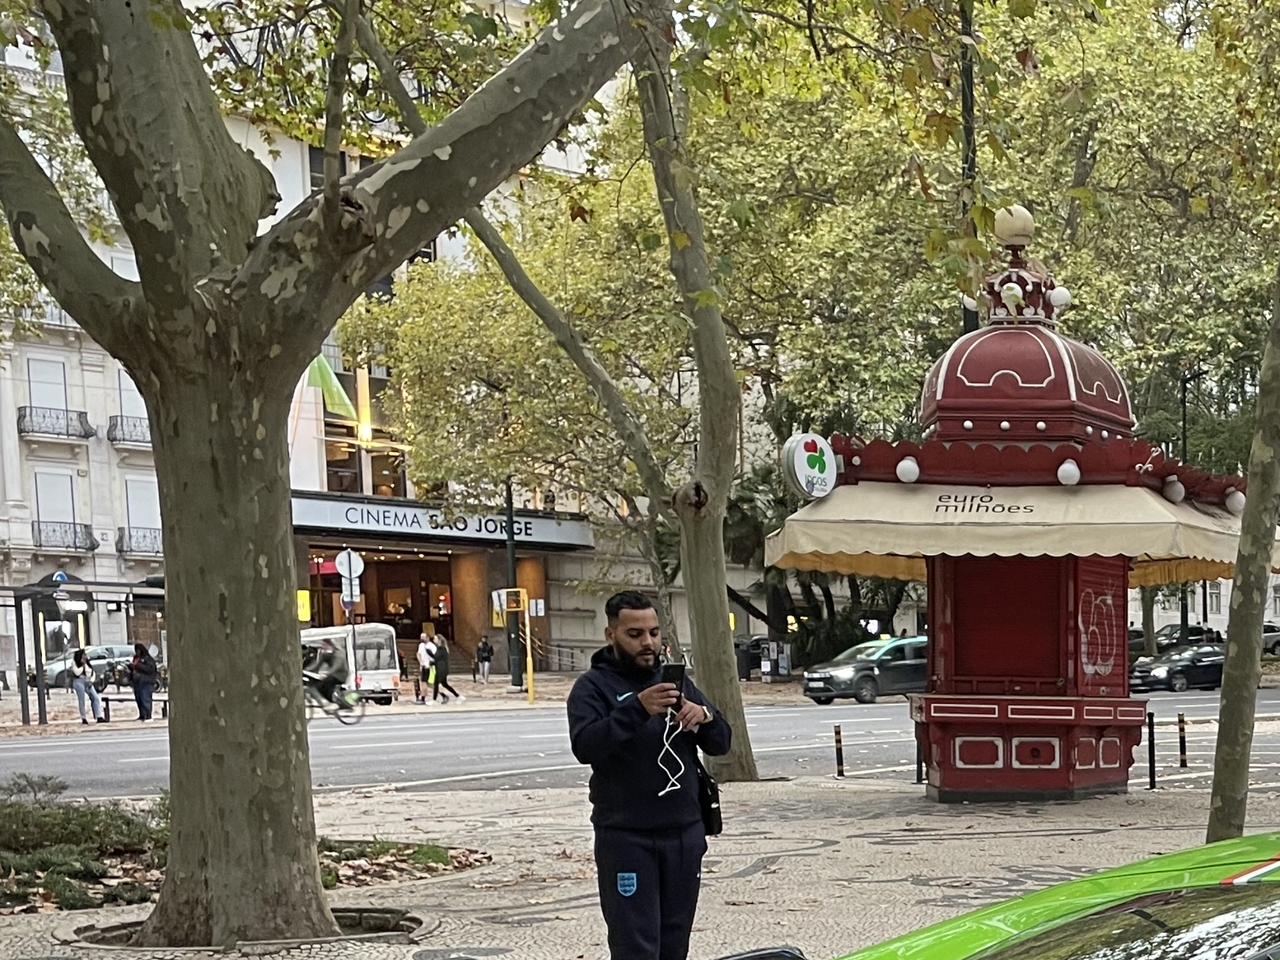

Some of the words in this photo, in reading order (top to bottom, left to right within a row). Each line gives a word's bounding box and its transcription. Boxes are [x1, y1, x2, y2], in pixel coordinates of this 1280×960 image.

[938, 494, 994, 503] euro
[935, 503, 1035, 514] milhões
[345, 507, 422, 529] CINEMA
